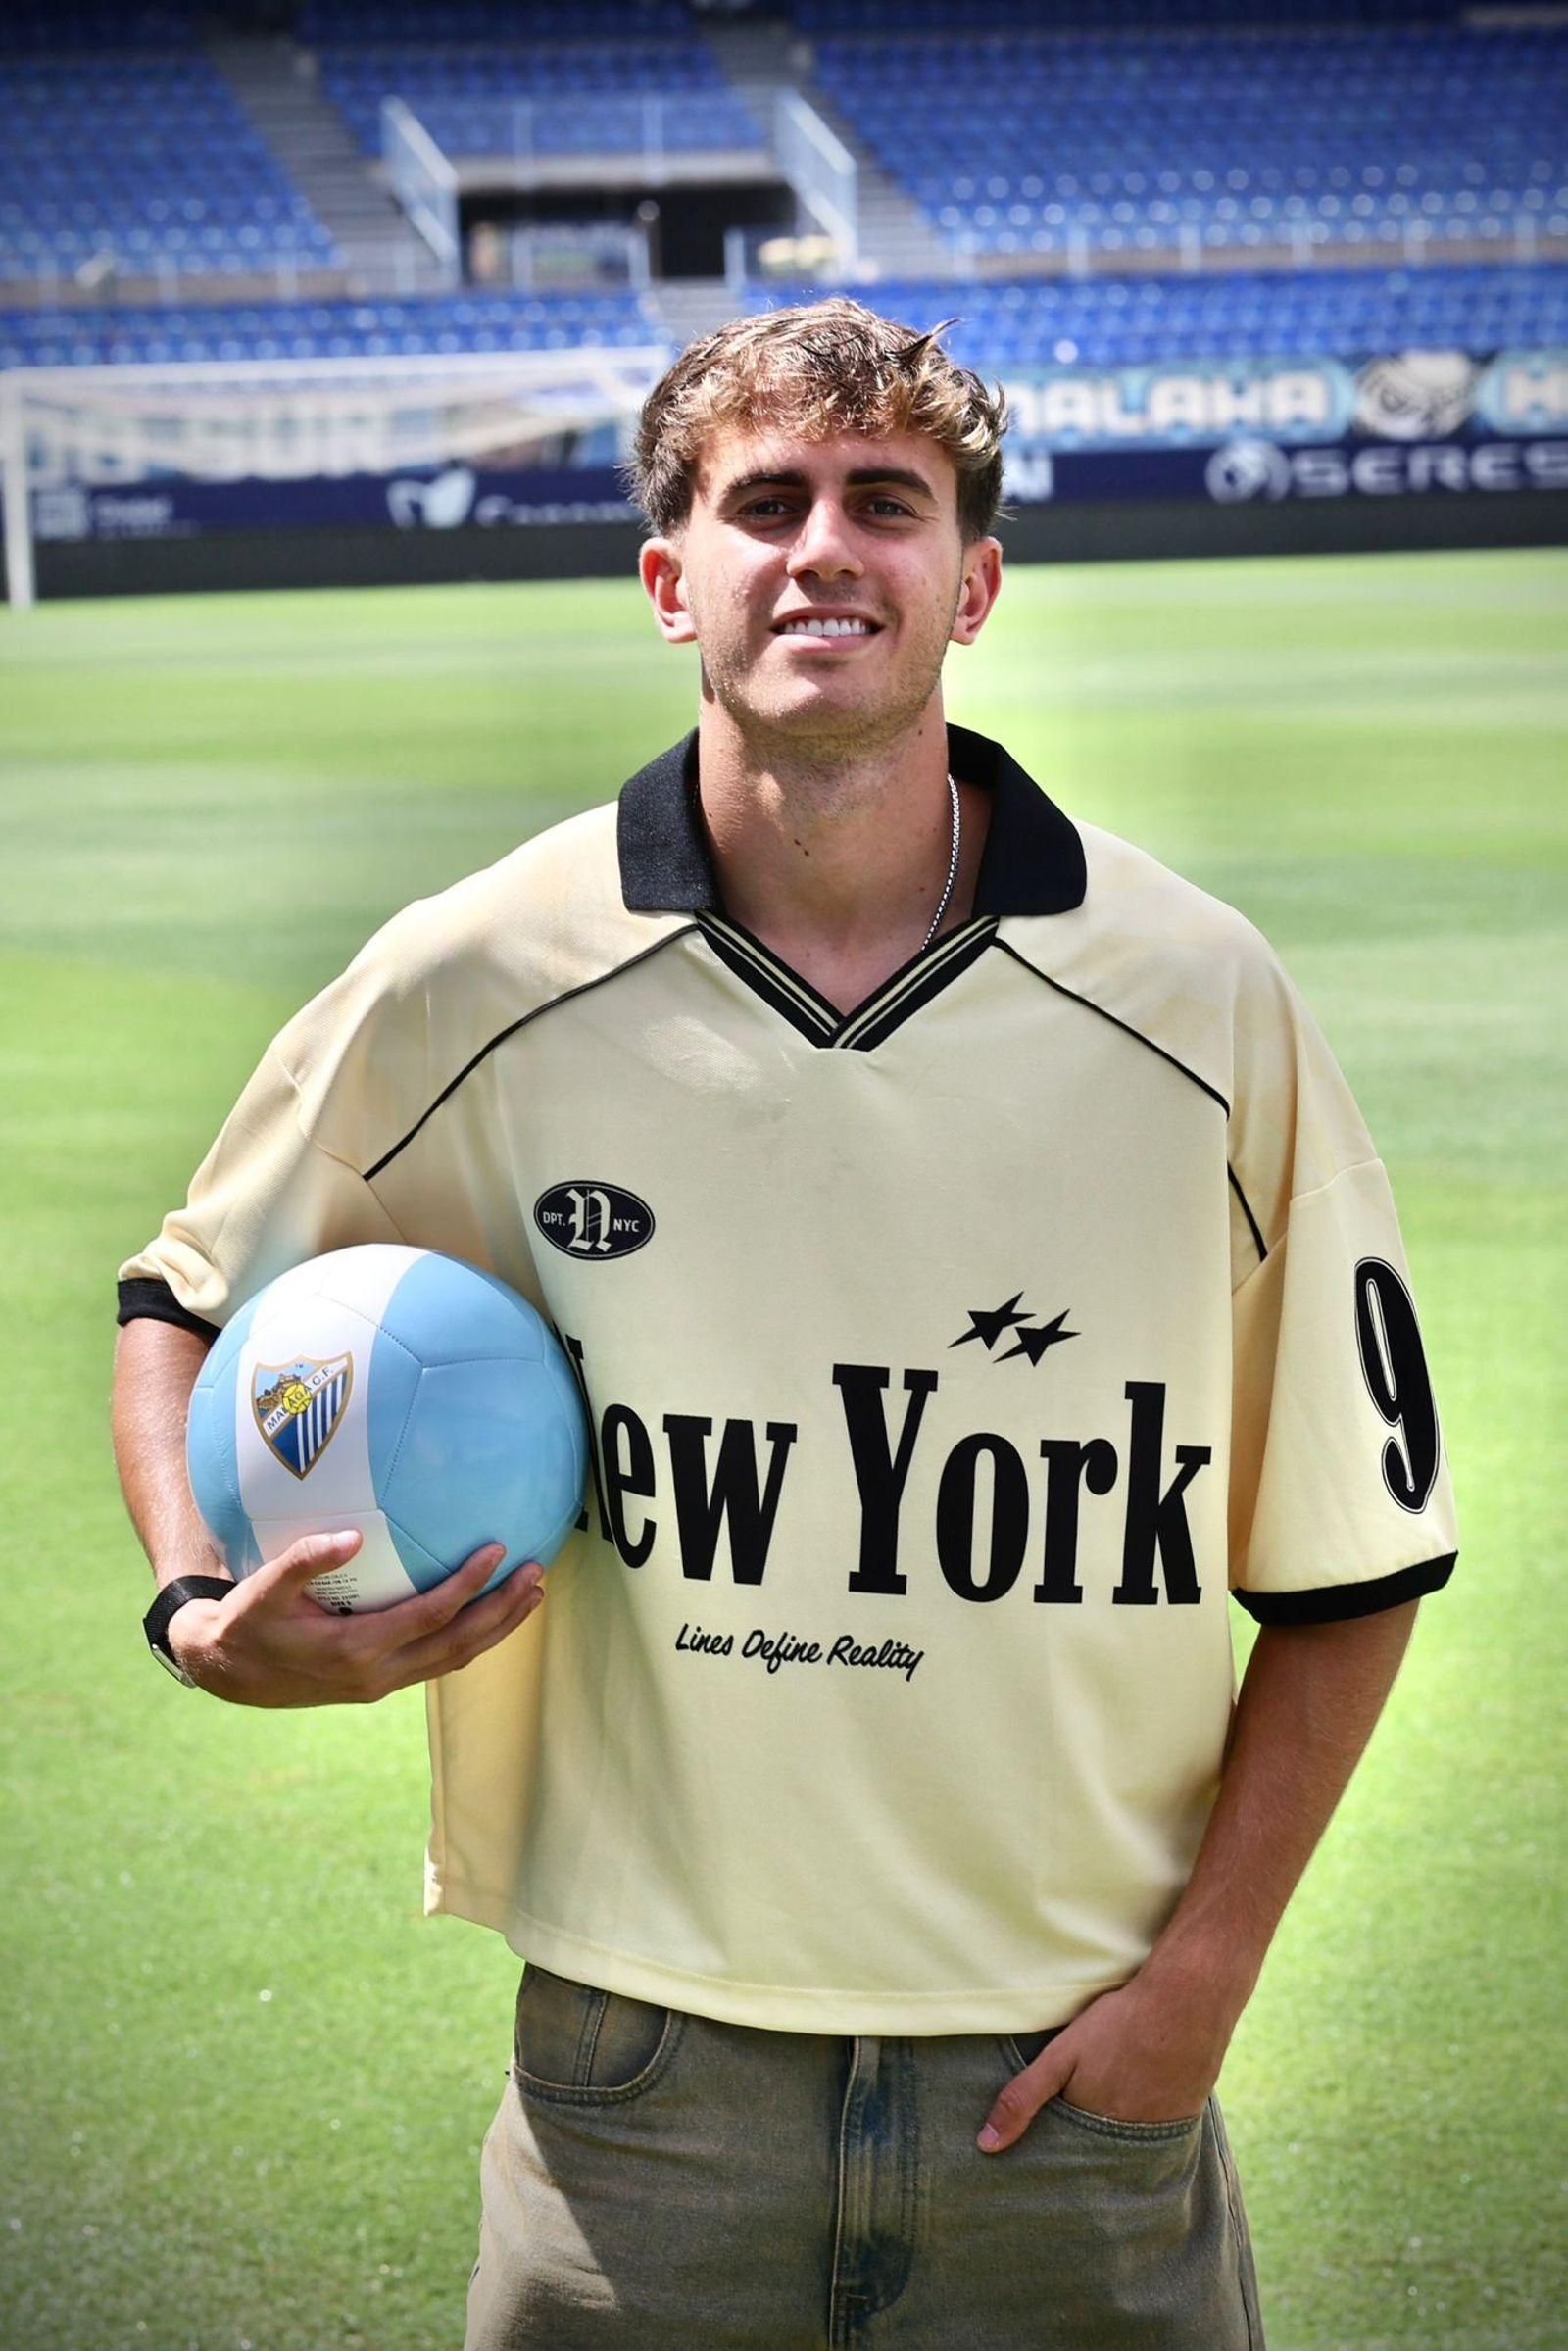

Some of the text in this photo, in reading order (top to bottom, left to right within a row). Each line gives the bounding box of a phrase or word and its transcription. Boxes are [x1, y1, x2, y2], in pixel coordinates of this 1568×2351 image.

[613, 1218, 640, 1233] NYC
[1354, 1256, 1440, 1515] 9
[565, 1335, 1211, 1605] ew York
[676, 1623, 924, 1682] Lines Define Reality
